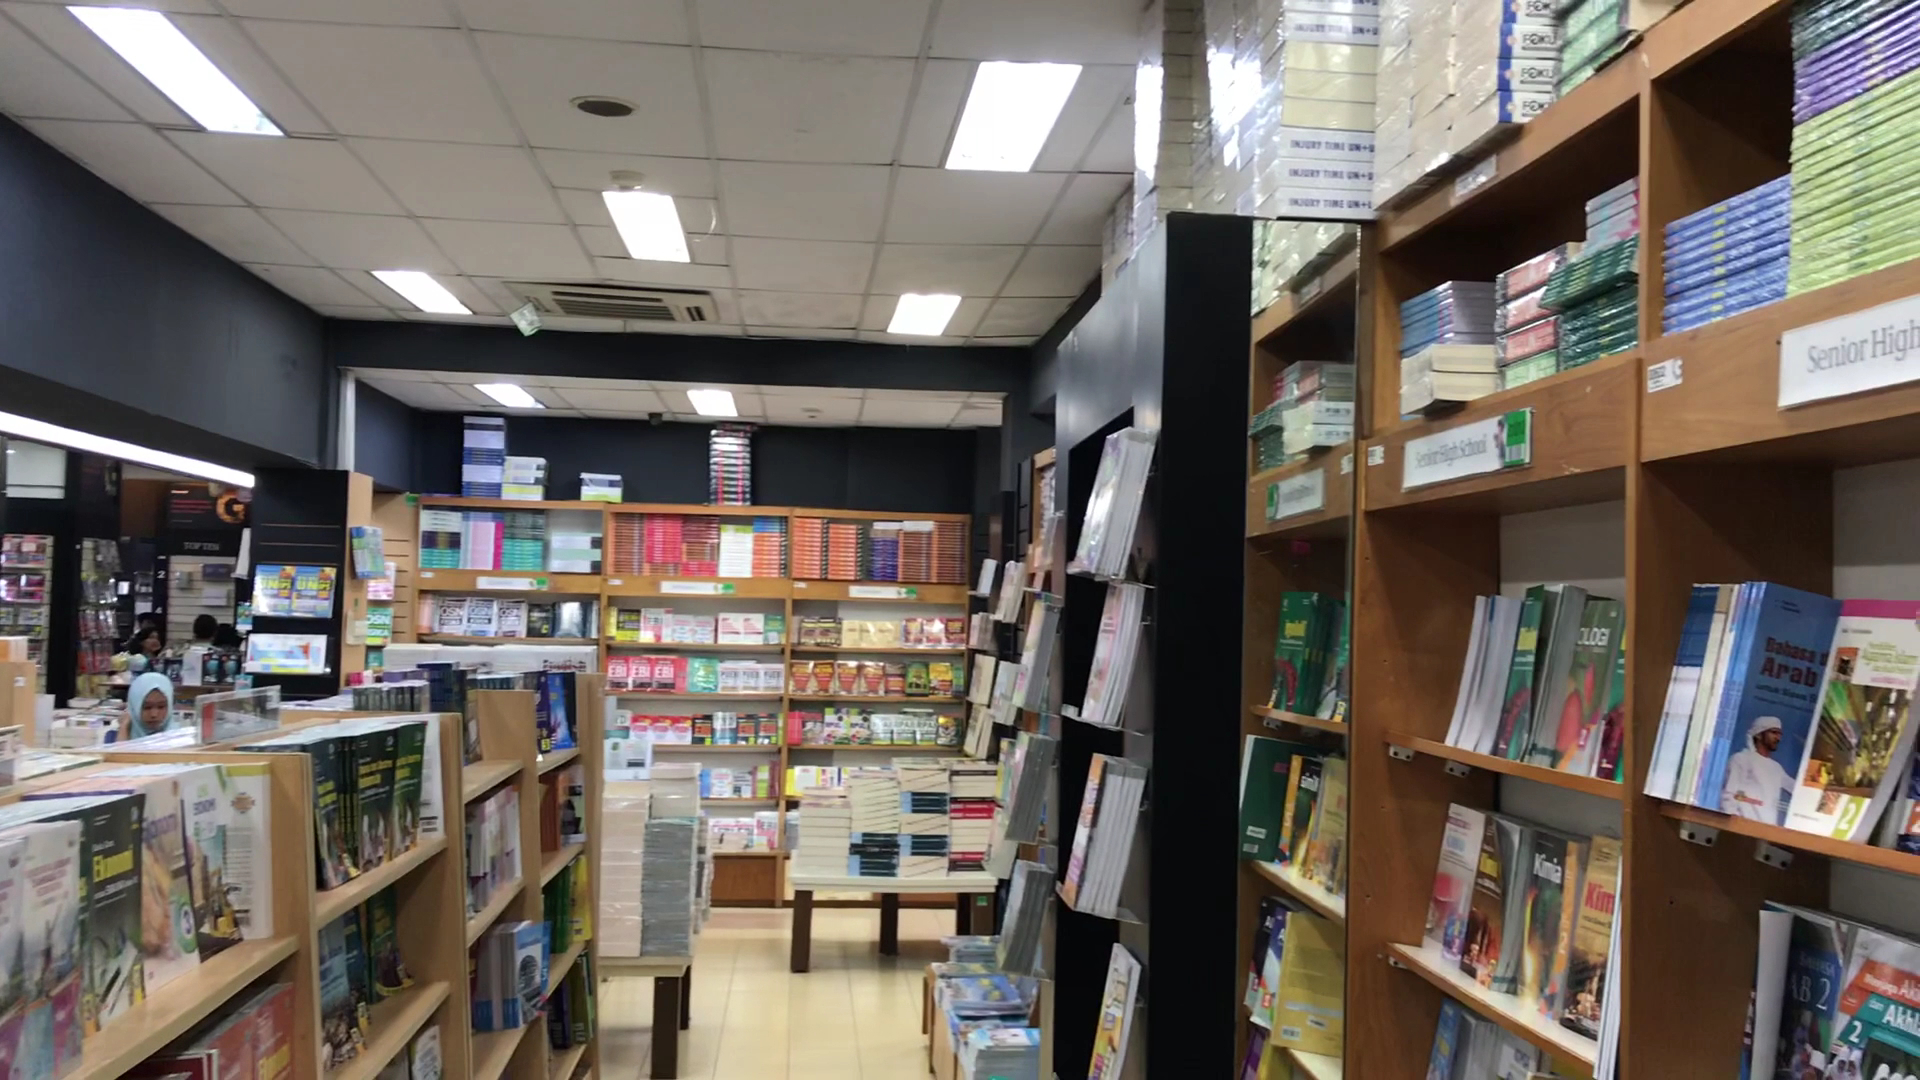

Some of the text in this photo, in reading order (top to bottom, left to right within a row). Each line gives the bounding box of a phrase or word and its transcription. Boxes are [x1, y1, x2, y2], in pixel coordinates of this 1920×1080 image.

[1807, 318, 1920, 373] Senior High
[1415, 446, 1439, 468] Senior
[1438, 440, 1460, 467] High
[1459, 433, 1487, 459] School
[184, 542, 219, 551] TOP TEN
[1766, 637, 1816, 662] Bahasa
[1760, 656, 1817, 688] Arab
[1839, 803, 1856, 830] 2
[1533, 852, 1562, 884] Kimia
[1815, 978, 1832, 1011] 2
[1847, 1020, 1862, 1044] 2
